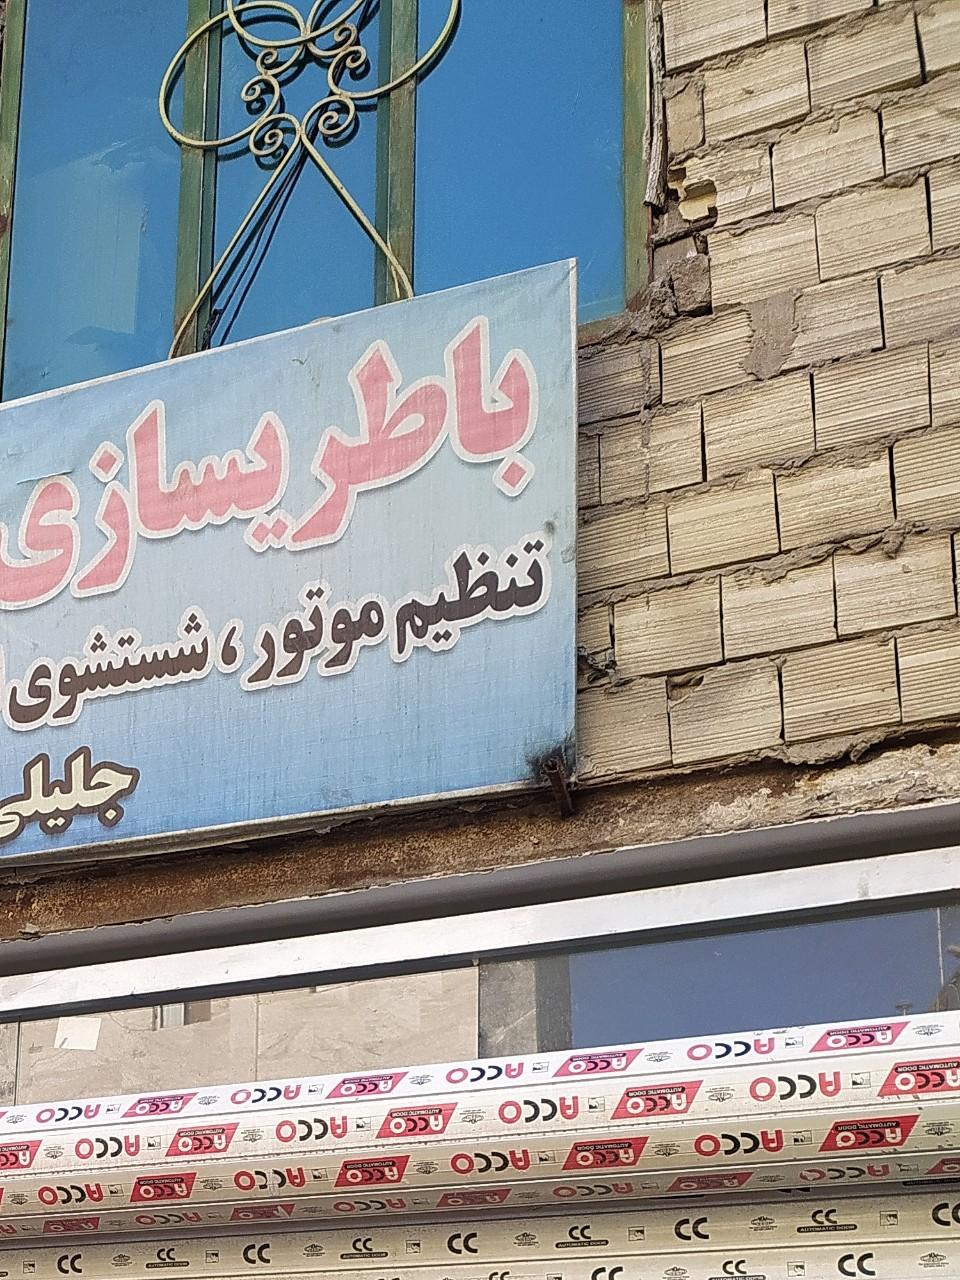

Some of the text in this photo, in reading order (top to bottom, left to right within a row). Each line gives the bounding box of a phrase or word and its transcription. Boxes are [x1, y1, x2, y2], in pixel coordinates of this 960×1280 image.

[394, 538, 545, 655] تنظیم
[10, 614, 210, 727] شستشوی
[686, 1037, 775, 1061] ACCO
[446, 1062, 524, 1084] ACCO
[230, 1085, 301, 1104] ACCO
[749, 1071, 840, 1102] ACCO
[35, 1104, 101, 1123] ACCO
[498, 1096, 579, 1124] ACCO
[275, 1116, 347, 1143] ACCO
[75, 1135, 140, 1159] ACCO
[694, 1130, 784, 1156] ACCO
[451, 1149, 530, 1174] ACCO
[38, 1183, 104, 1205] ACCO
